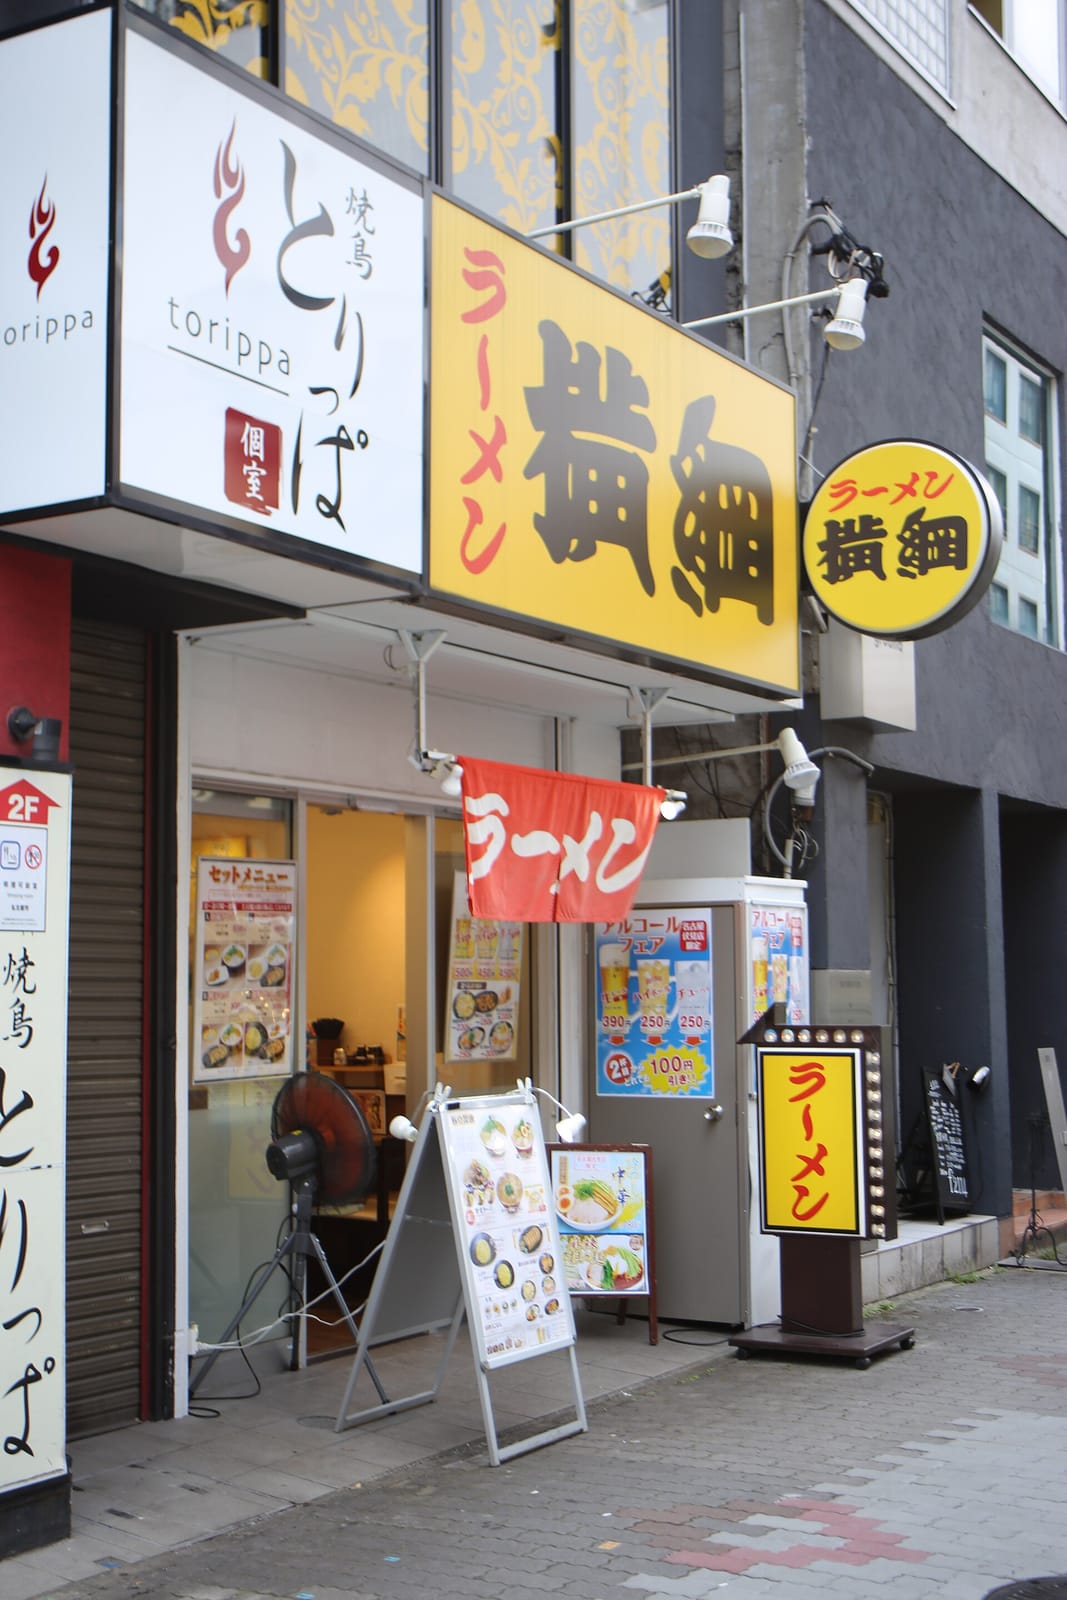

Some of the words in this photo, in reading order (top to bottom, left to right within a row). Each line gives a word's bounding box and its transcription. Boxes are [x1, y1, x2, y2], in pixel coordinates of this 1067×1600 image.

[345, 187, 375, 281] 焼鳥
[168, 296, 291, 376] torippa
[276, 139, 369, 532] とりっぱ
[460, 247, 508, 575] ラーメン
[240, 421, 266, 503] 個室
[829, 471, 955, 513] ラーメン
[7, 793, 40, 822] 2F
[464, 792, 651, 894] ラーメン
[208, 864, 289, 885] セットメニュー
[601, 916, 680, 936] アルコール
[618, 936, 666, 955] フェア
[2, 946, 37, 1049] 焼鳥
[788, 1062, 830, 1221] ラーメン
